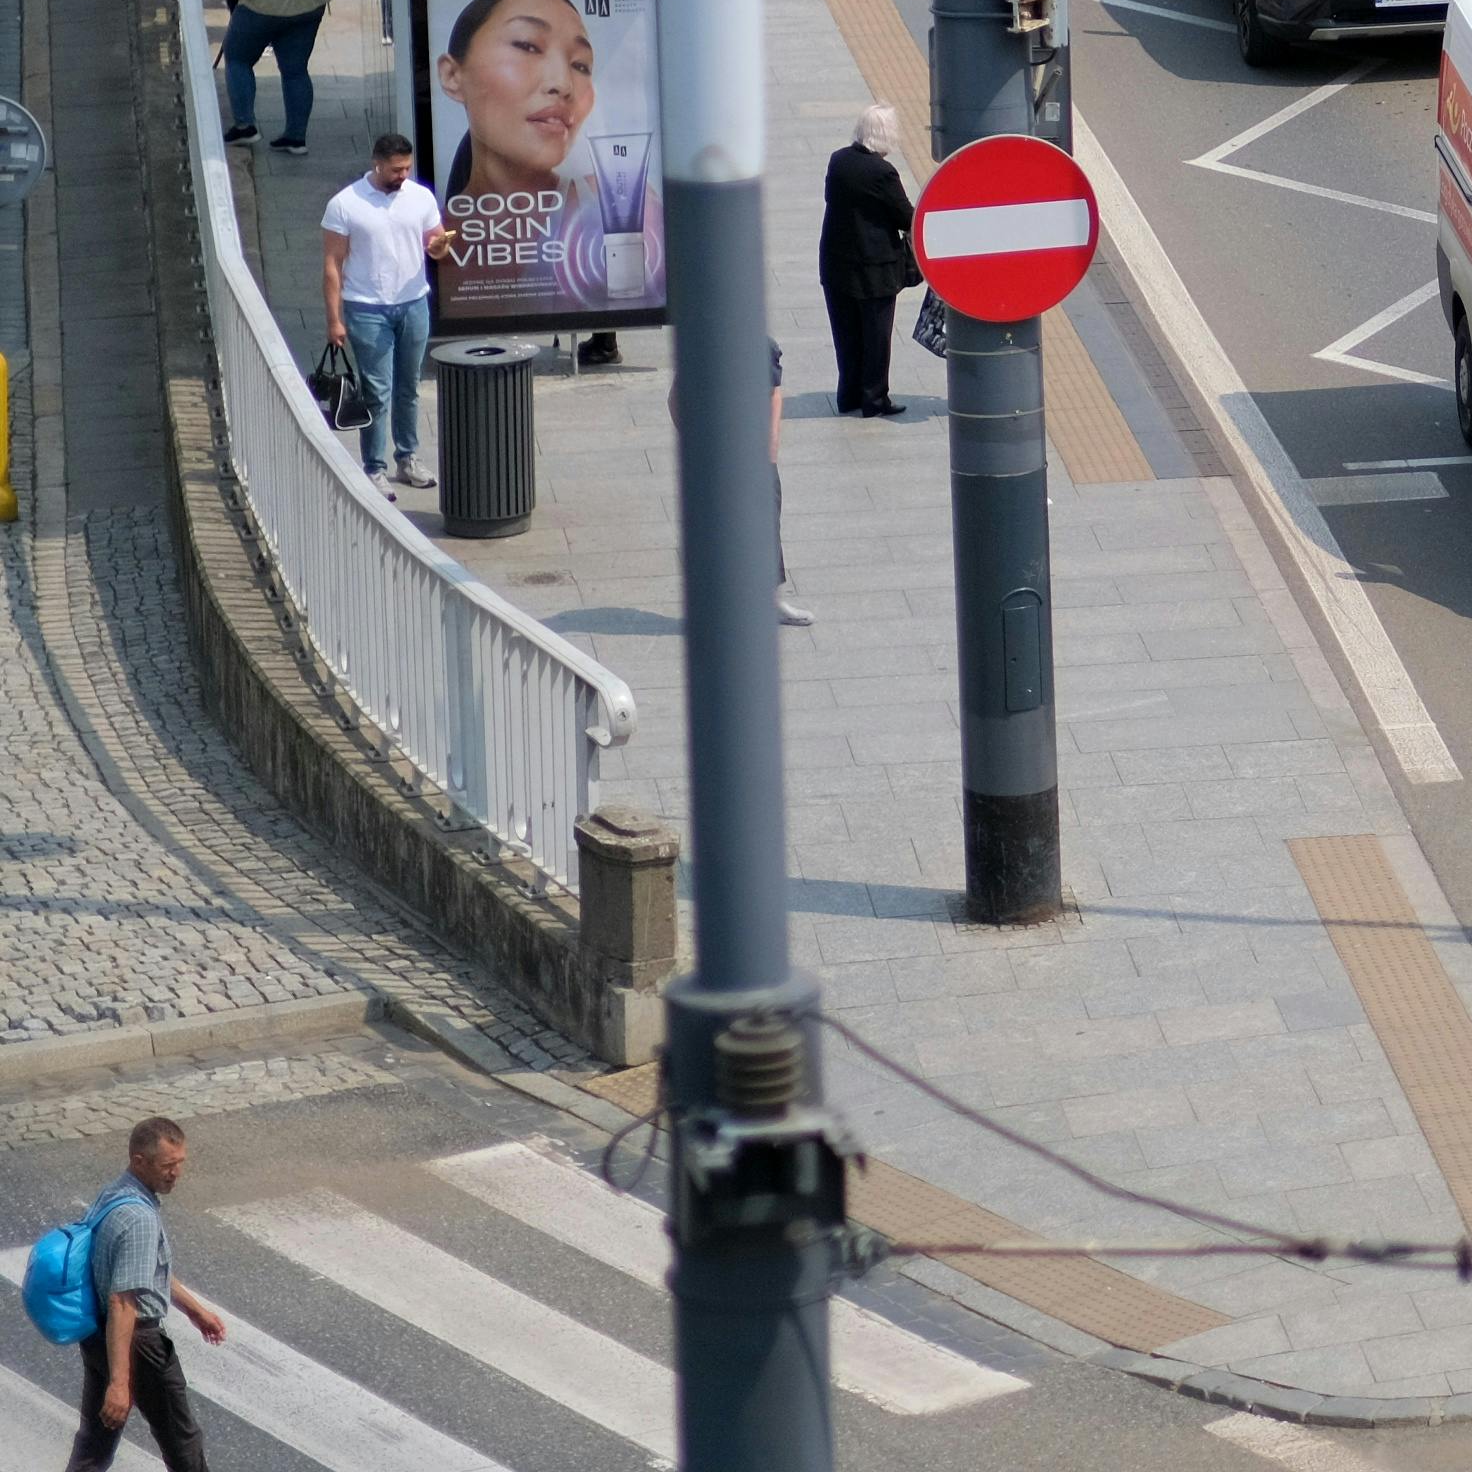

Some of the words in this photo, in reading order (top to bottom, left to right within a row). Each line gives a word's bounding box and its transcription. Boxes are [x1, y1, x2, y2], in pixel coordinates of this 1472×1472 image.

[447, 190, 563, 216] GOOD
[461, 216, 551, 241] SKIN
[448, 240, 565, 267] VIBES
